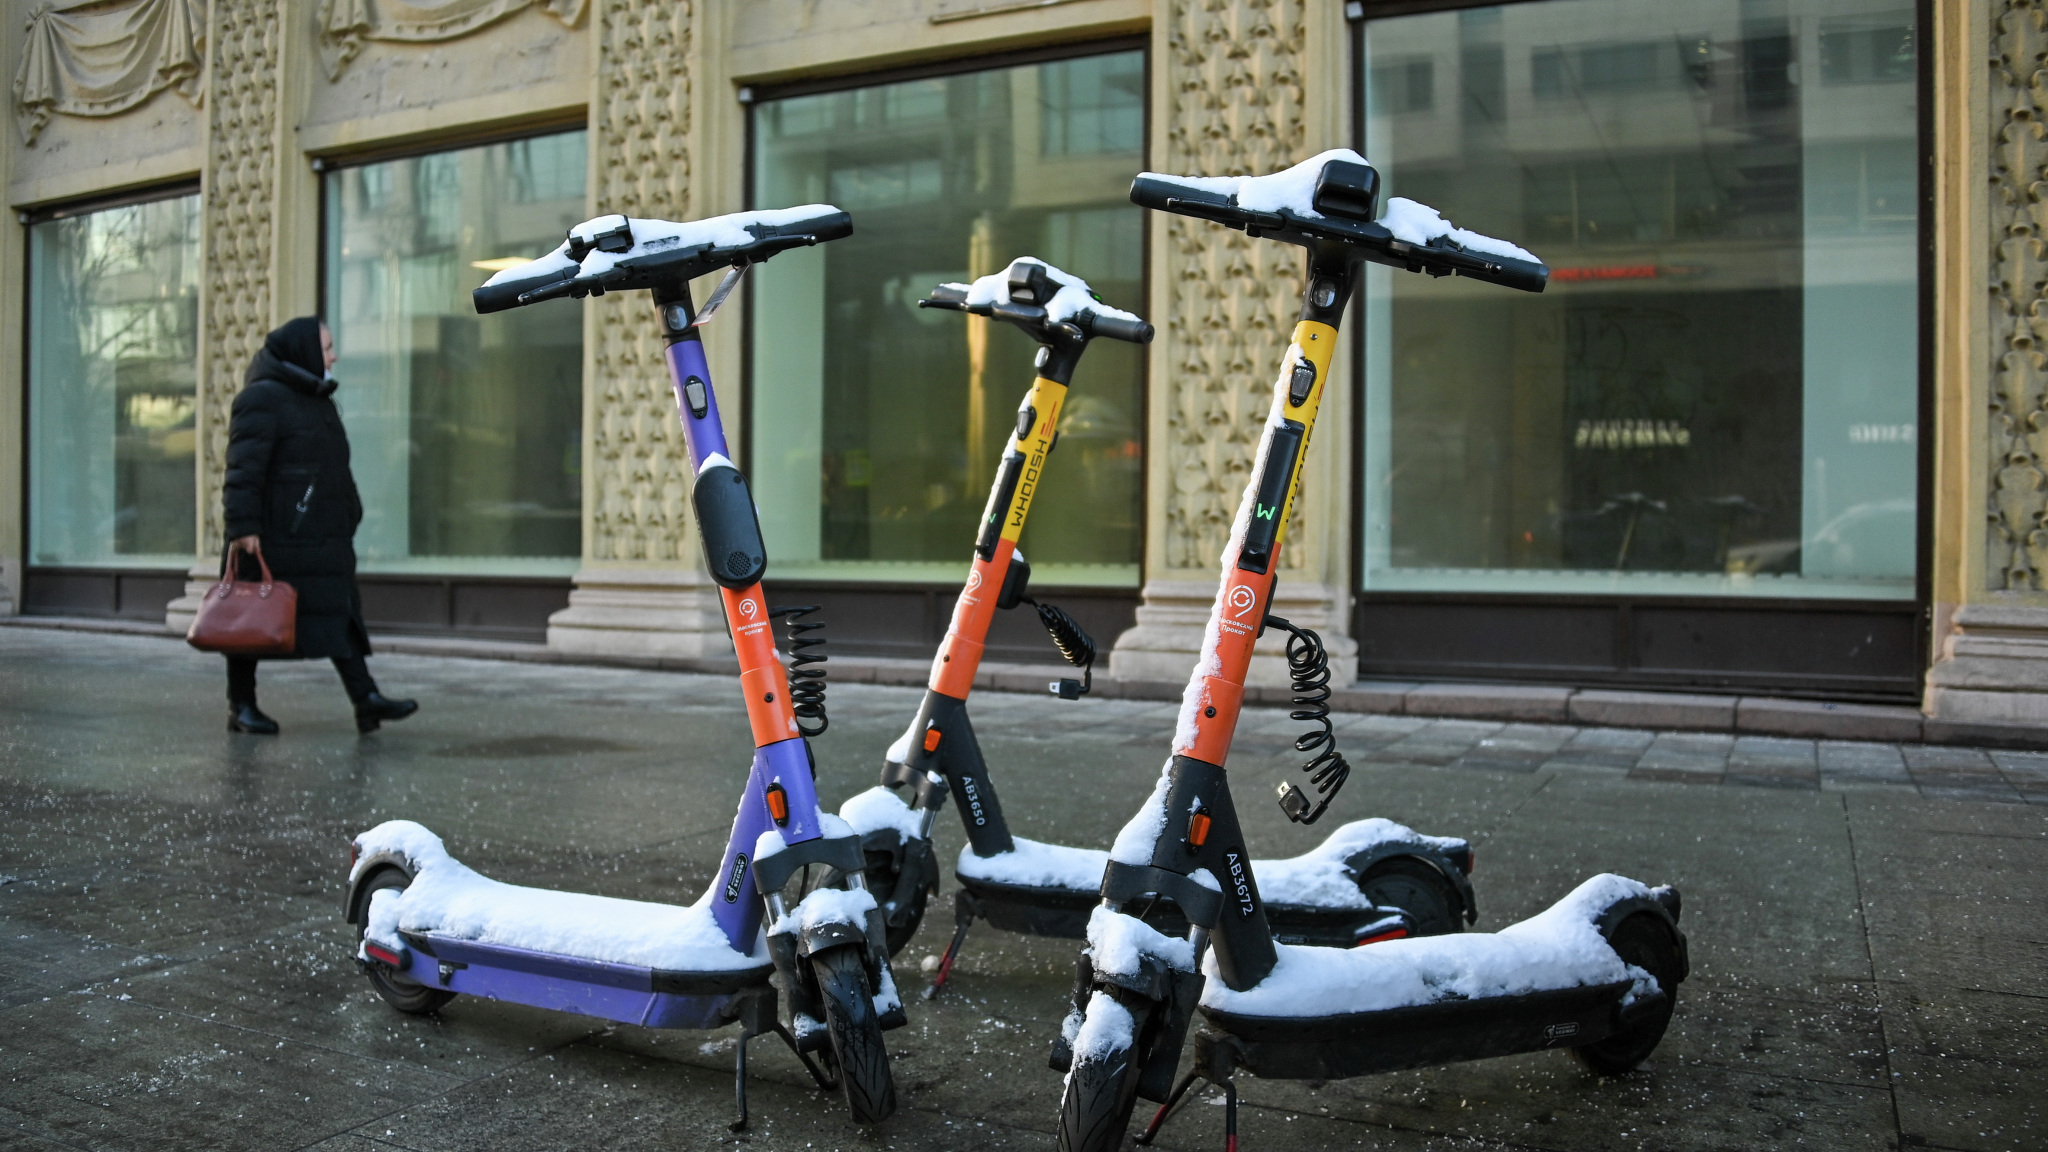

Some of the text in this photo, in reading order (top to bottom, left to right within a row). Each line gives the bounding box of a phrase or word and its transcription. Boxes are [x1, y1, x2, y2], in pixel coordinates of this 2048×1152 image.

[1010, 438, 1048, 527] WHOOSH
[1256, 502, 1276, 521] W
[1221, 624, 1246, 636] Прокат
[961, 776, 986, 826] AB3650
[1226, 853, 1254, 916] AB3672
